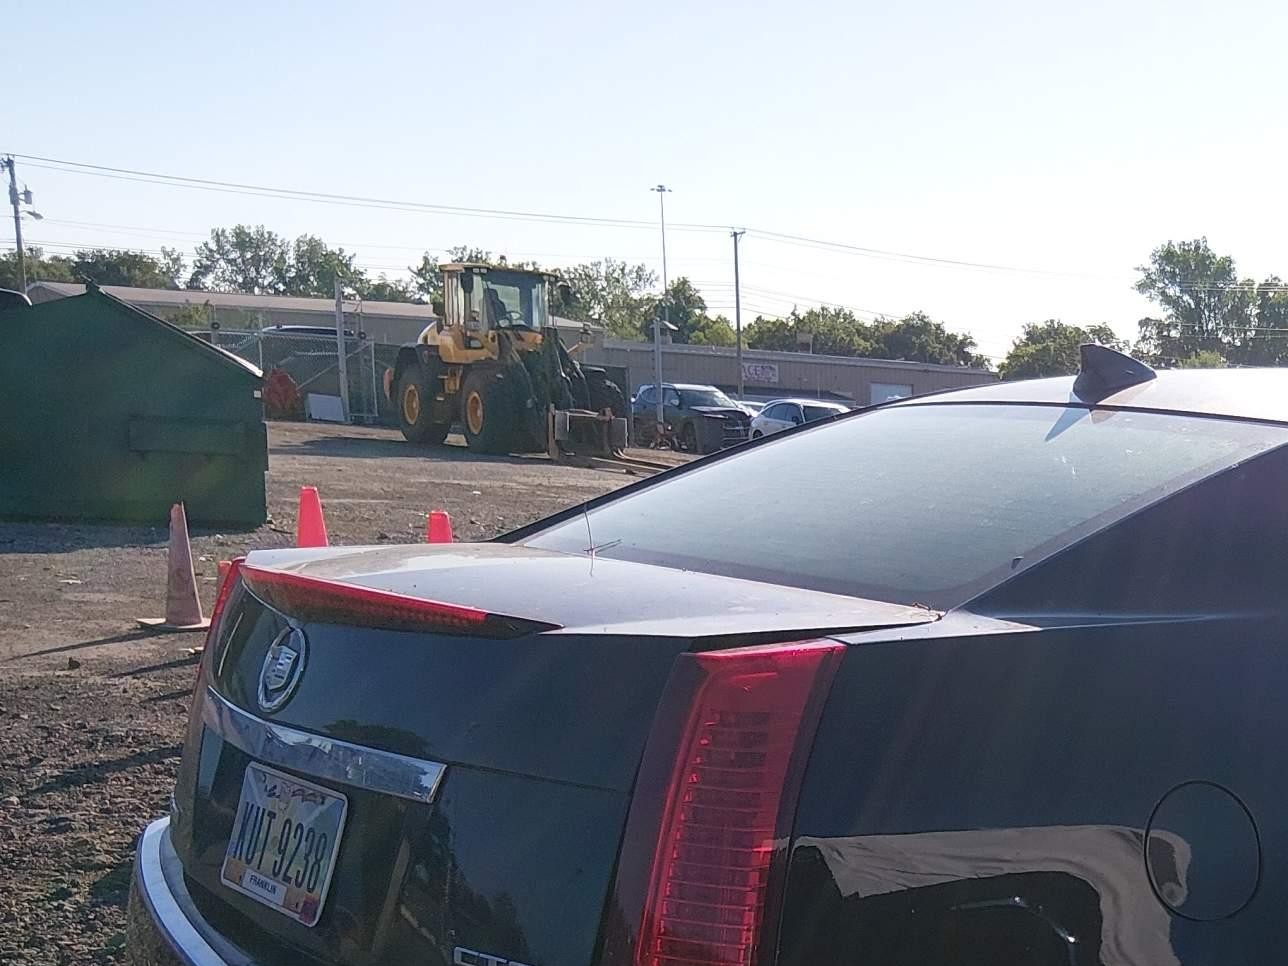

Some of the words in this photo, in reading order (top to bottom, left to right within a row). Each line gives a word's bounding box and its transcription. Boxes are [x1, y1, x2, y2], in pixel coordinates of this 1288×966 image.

[232, 800, 277, 870] KUT
[272, 818, 328, 893] 9238
[249, 874, 277, 895] FRANKLIN
